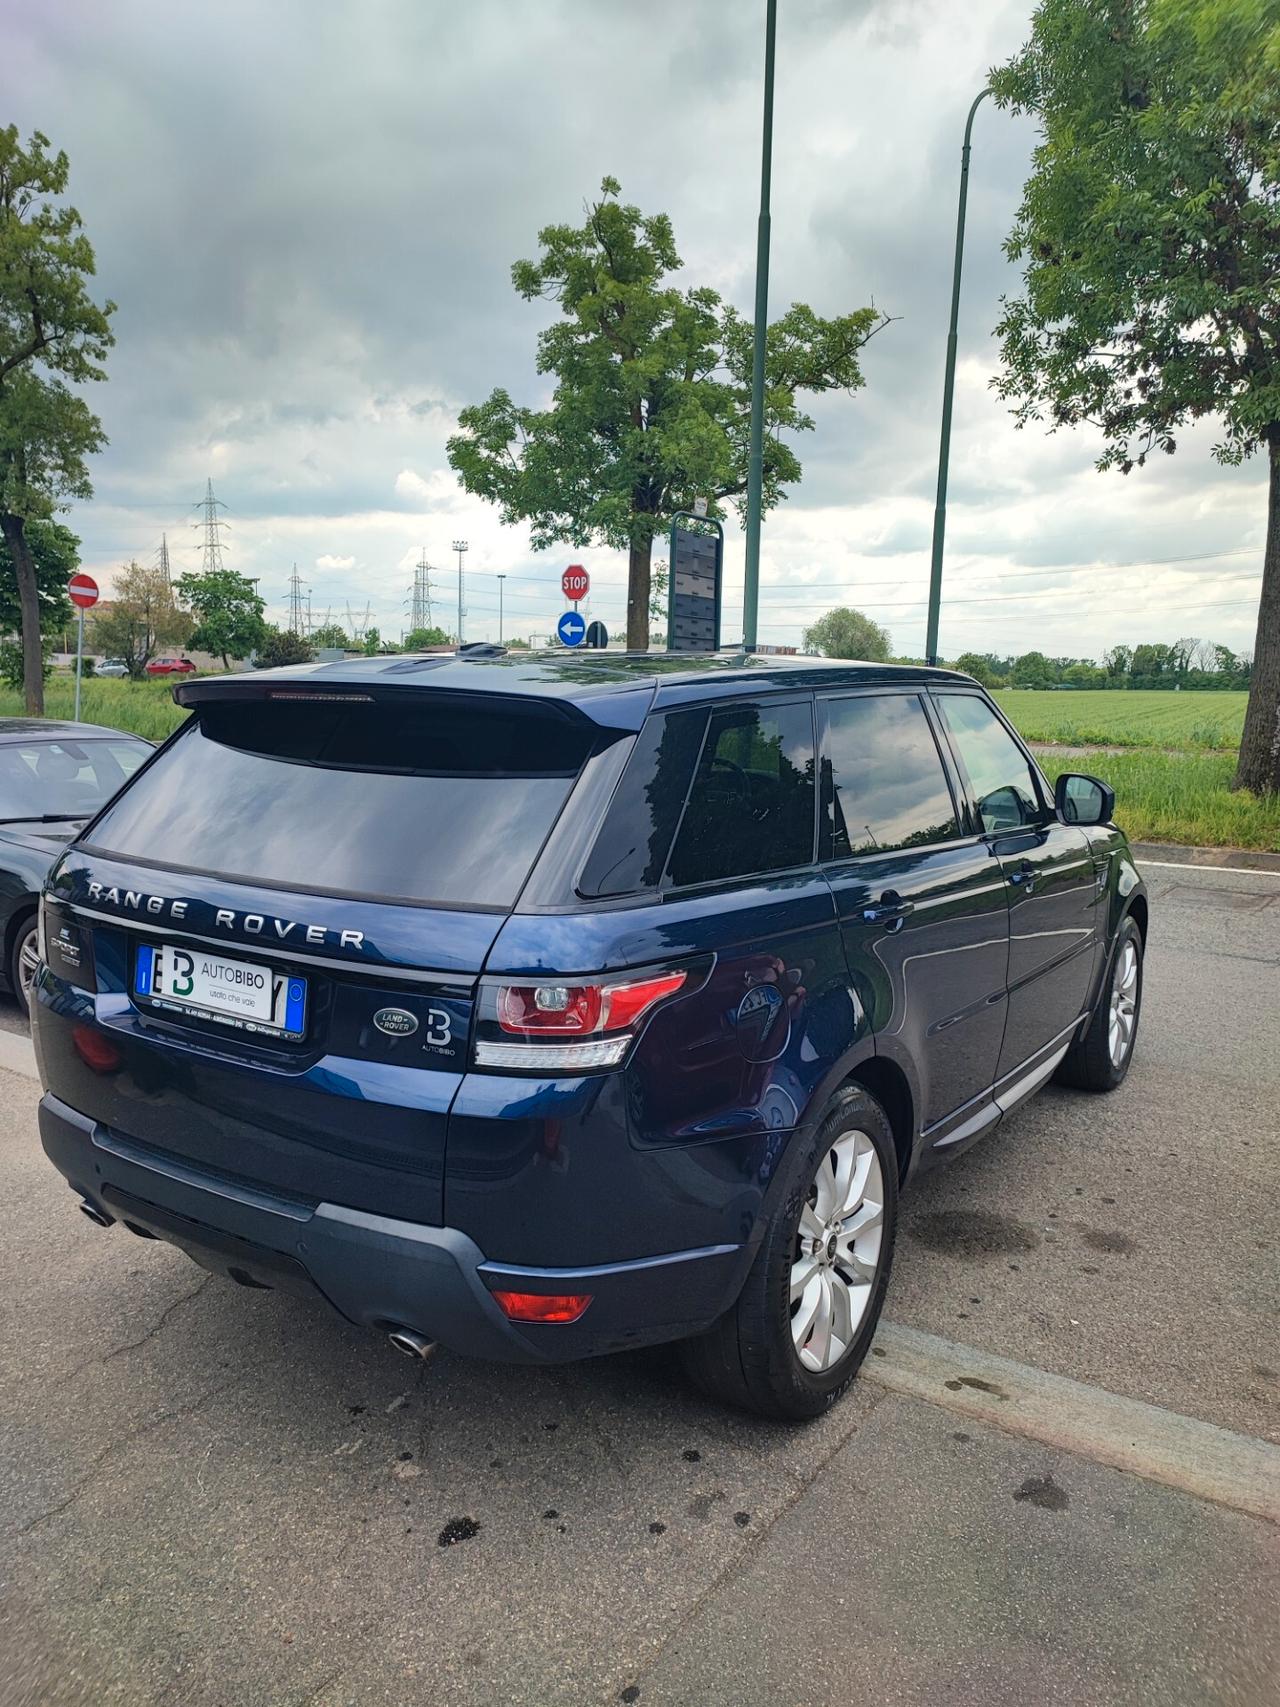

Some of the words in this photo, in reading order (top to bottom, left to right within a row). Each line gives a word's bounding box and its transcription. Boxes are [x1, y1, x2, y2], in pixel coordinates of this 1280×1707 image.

[563, 576, 587, 590] STOP
[88, 882, 188, 919] RANGE
[215, 909, 364, 950] ROVER
[201, 962, 265, 990] AUTOBIBO
[209, 989, 227, 1000] usato
[228, 992, 241, 1004] che
[241, 996, 256, 1008] vale
[382, 1013, 403, 1022] LAND
[384, 1022, 410, 1031] ROVER
[421, 1045, 456, 1056] AUTOBIBO
